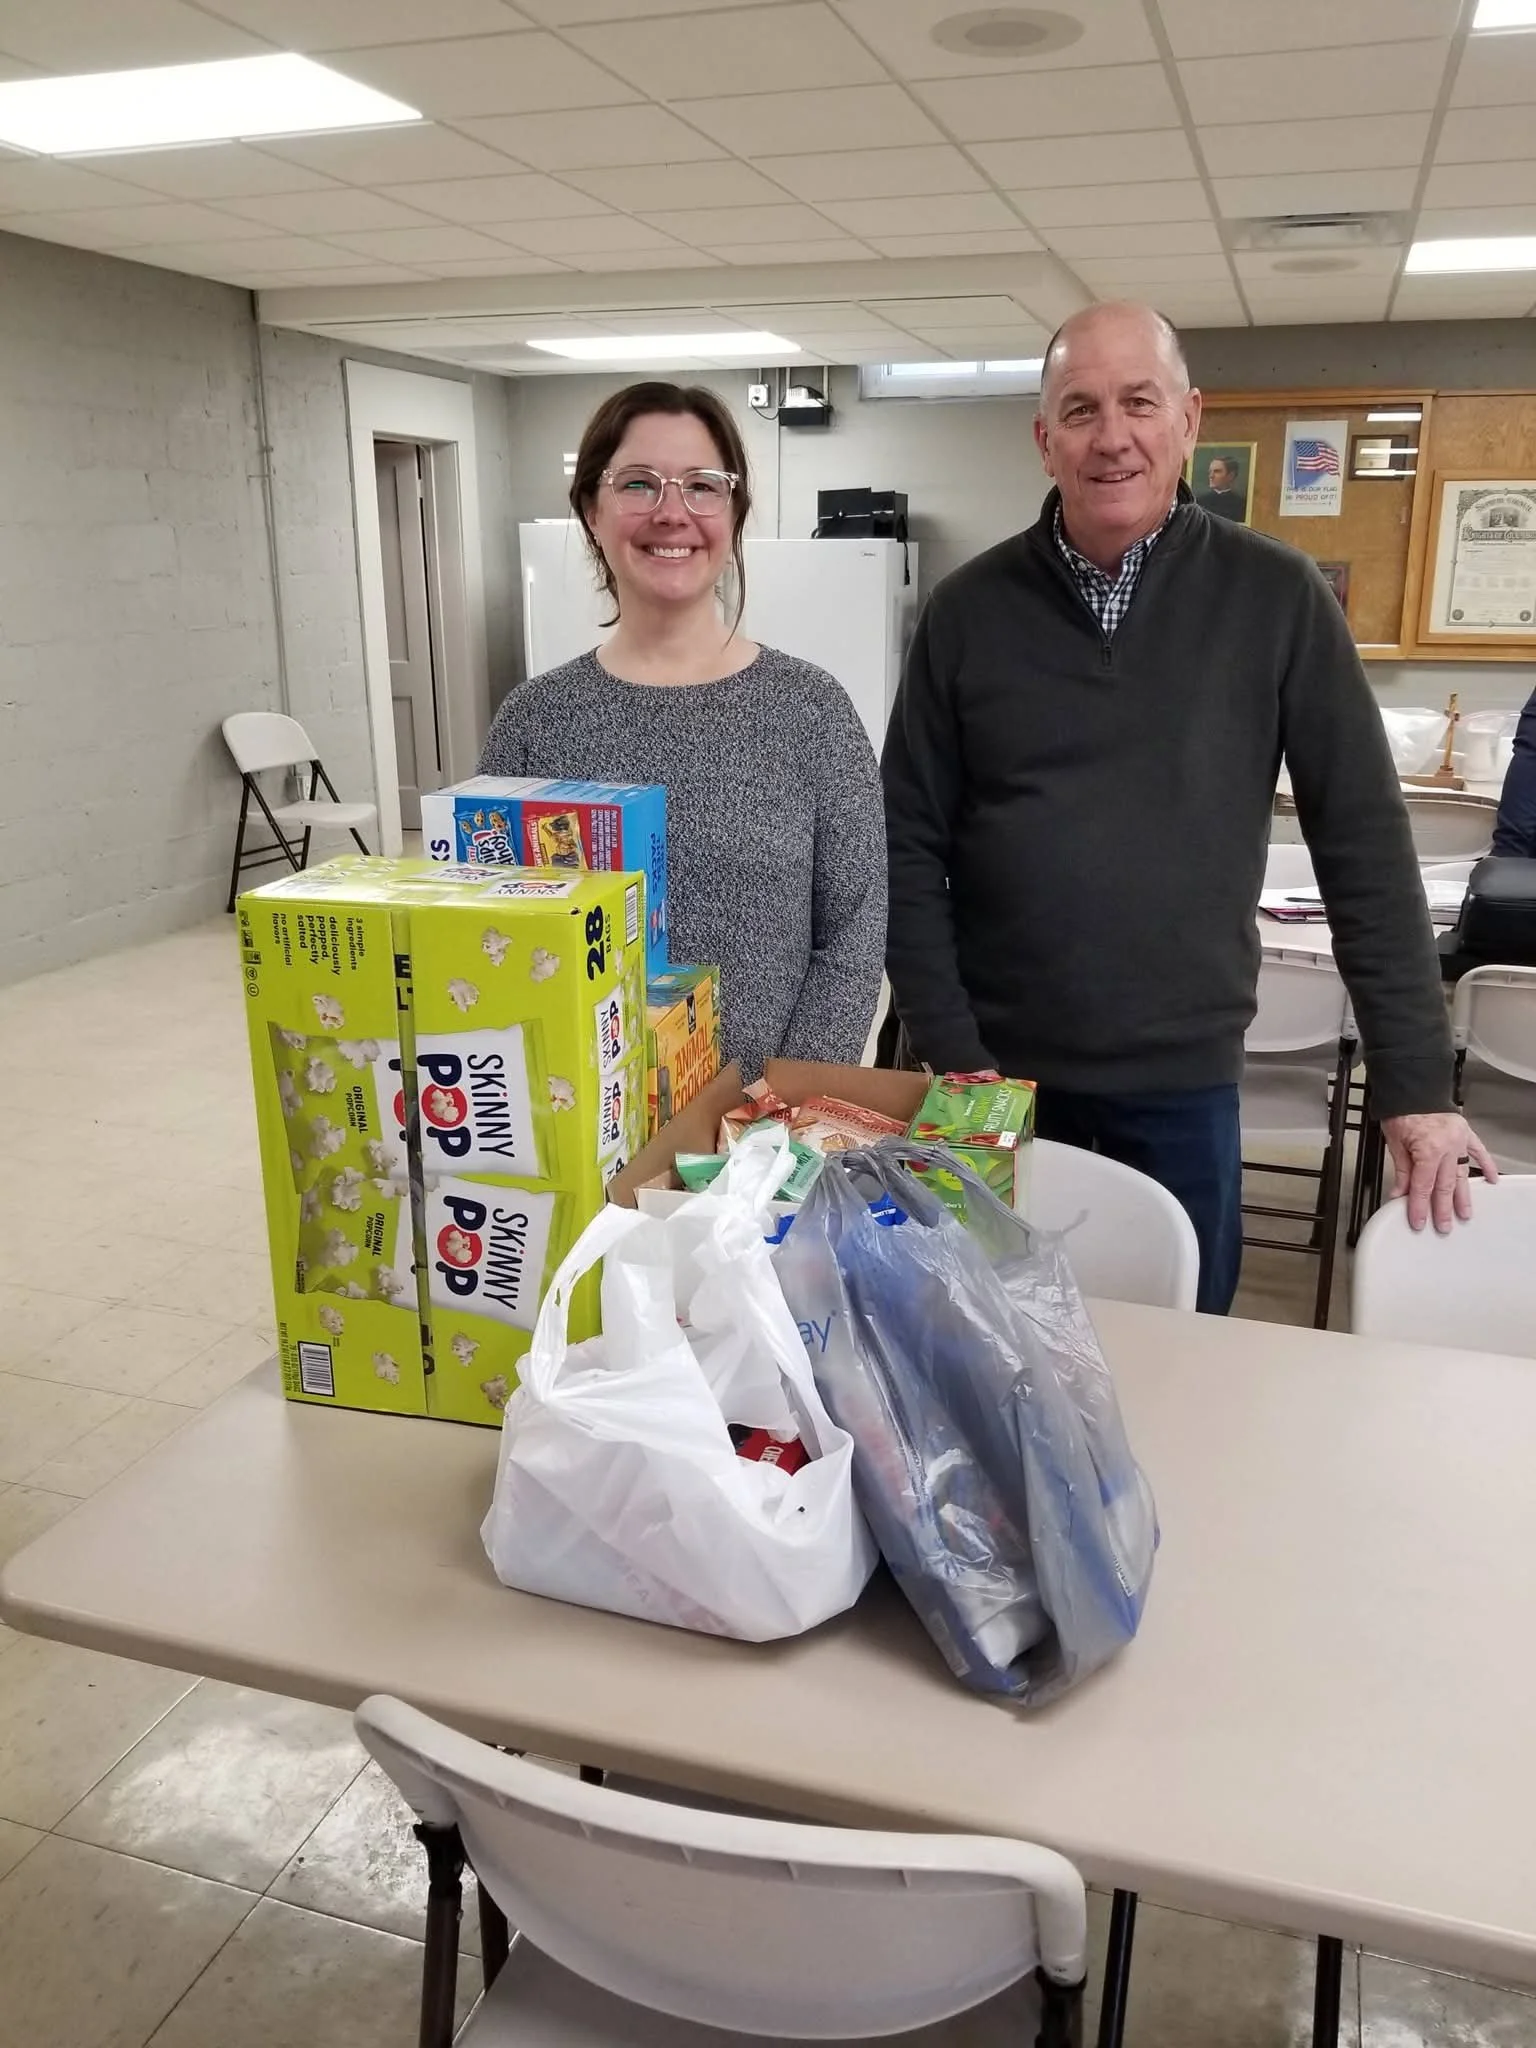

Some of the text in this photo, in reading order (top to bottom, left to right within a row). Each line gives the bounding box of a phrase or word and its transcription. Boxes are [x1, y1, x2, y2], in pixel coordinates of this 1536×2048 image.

[496, 887, 561, 897] SKINNY
[271, 912, 281, 945] flavors
[280, 913, 293, 966] no artificial
[297, 914, 308, 949] salted
[305, 915, 319, 965] perfectly
[315, 915, 329, 961] popped,
[329, 916, 342, 976] deliciously
[345, 917, 357, 971] ingredients
[356, 925, 366, 957] simple
[585, 904, 606, 982] 28
[604, 913, 612, 953] BAGS
[600, 1009, 613, 1069] SKINNY
[609, 999, 622, 1058] POP
[674, 1021, 710, 1086] ANIMAL
[346, 1093, 356, 1127] POPCORN
[352, 1085, 369, 1134] ORIGINAL
[416, 1053, 472, 1158] POP
[467, 1054, 515, 1158] SKINNY
[672, 1050, 713, 1117] COOKIES
[991, 1089, 1012, 1113] SNACKS
[602, 1085, 613, 1146] SKINNY
[611, 1080, 622, 1142] POP
[365, 1215, 373, 1249] POPCORN
[372, 1212, 385, 1256] ORIGINAL
[435, 1194, 488, 1296] POP
[482, 1207, 529, 1310] SKINNY
